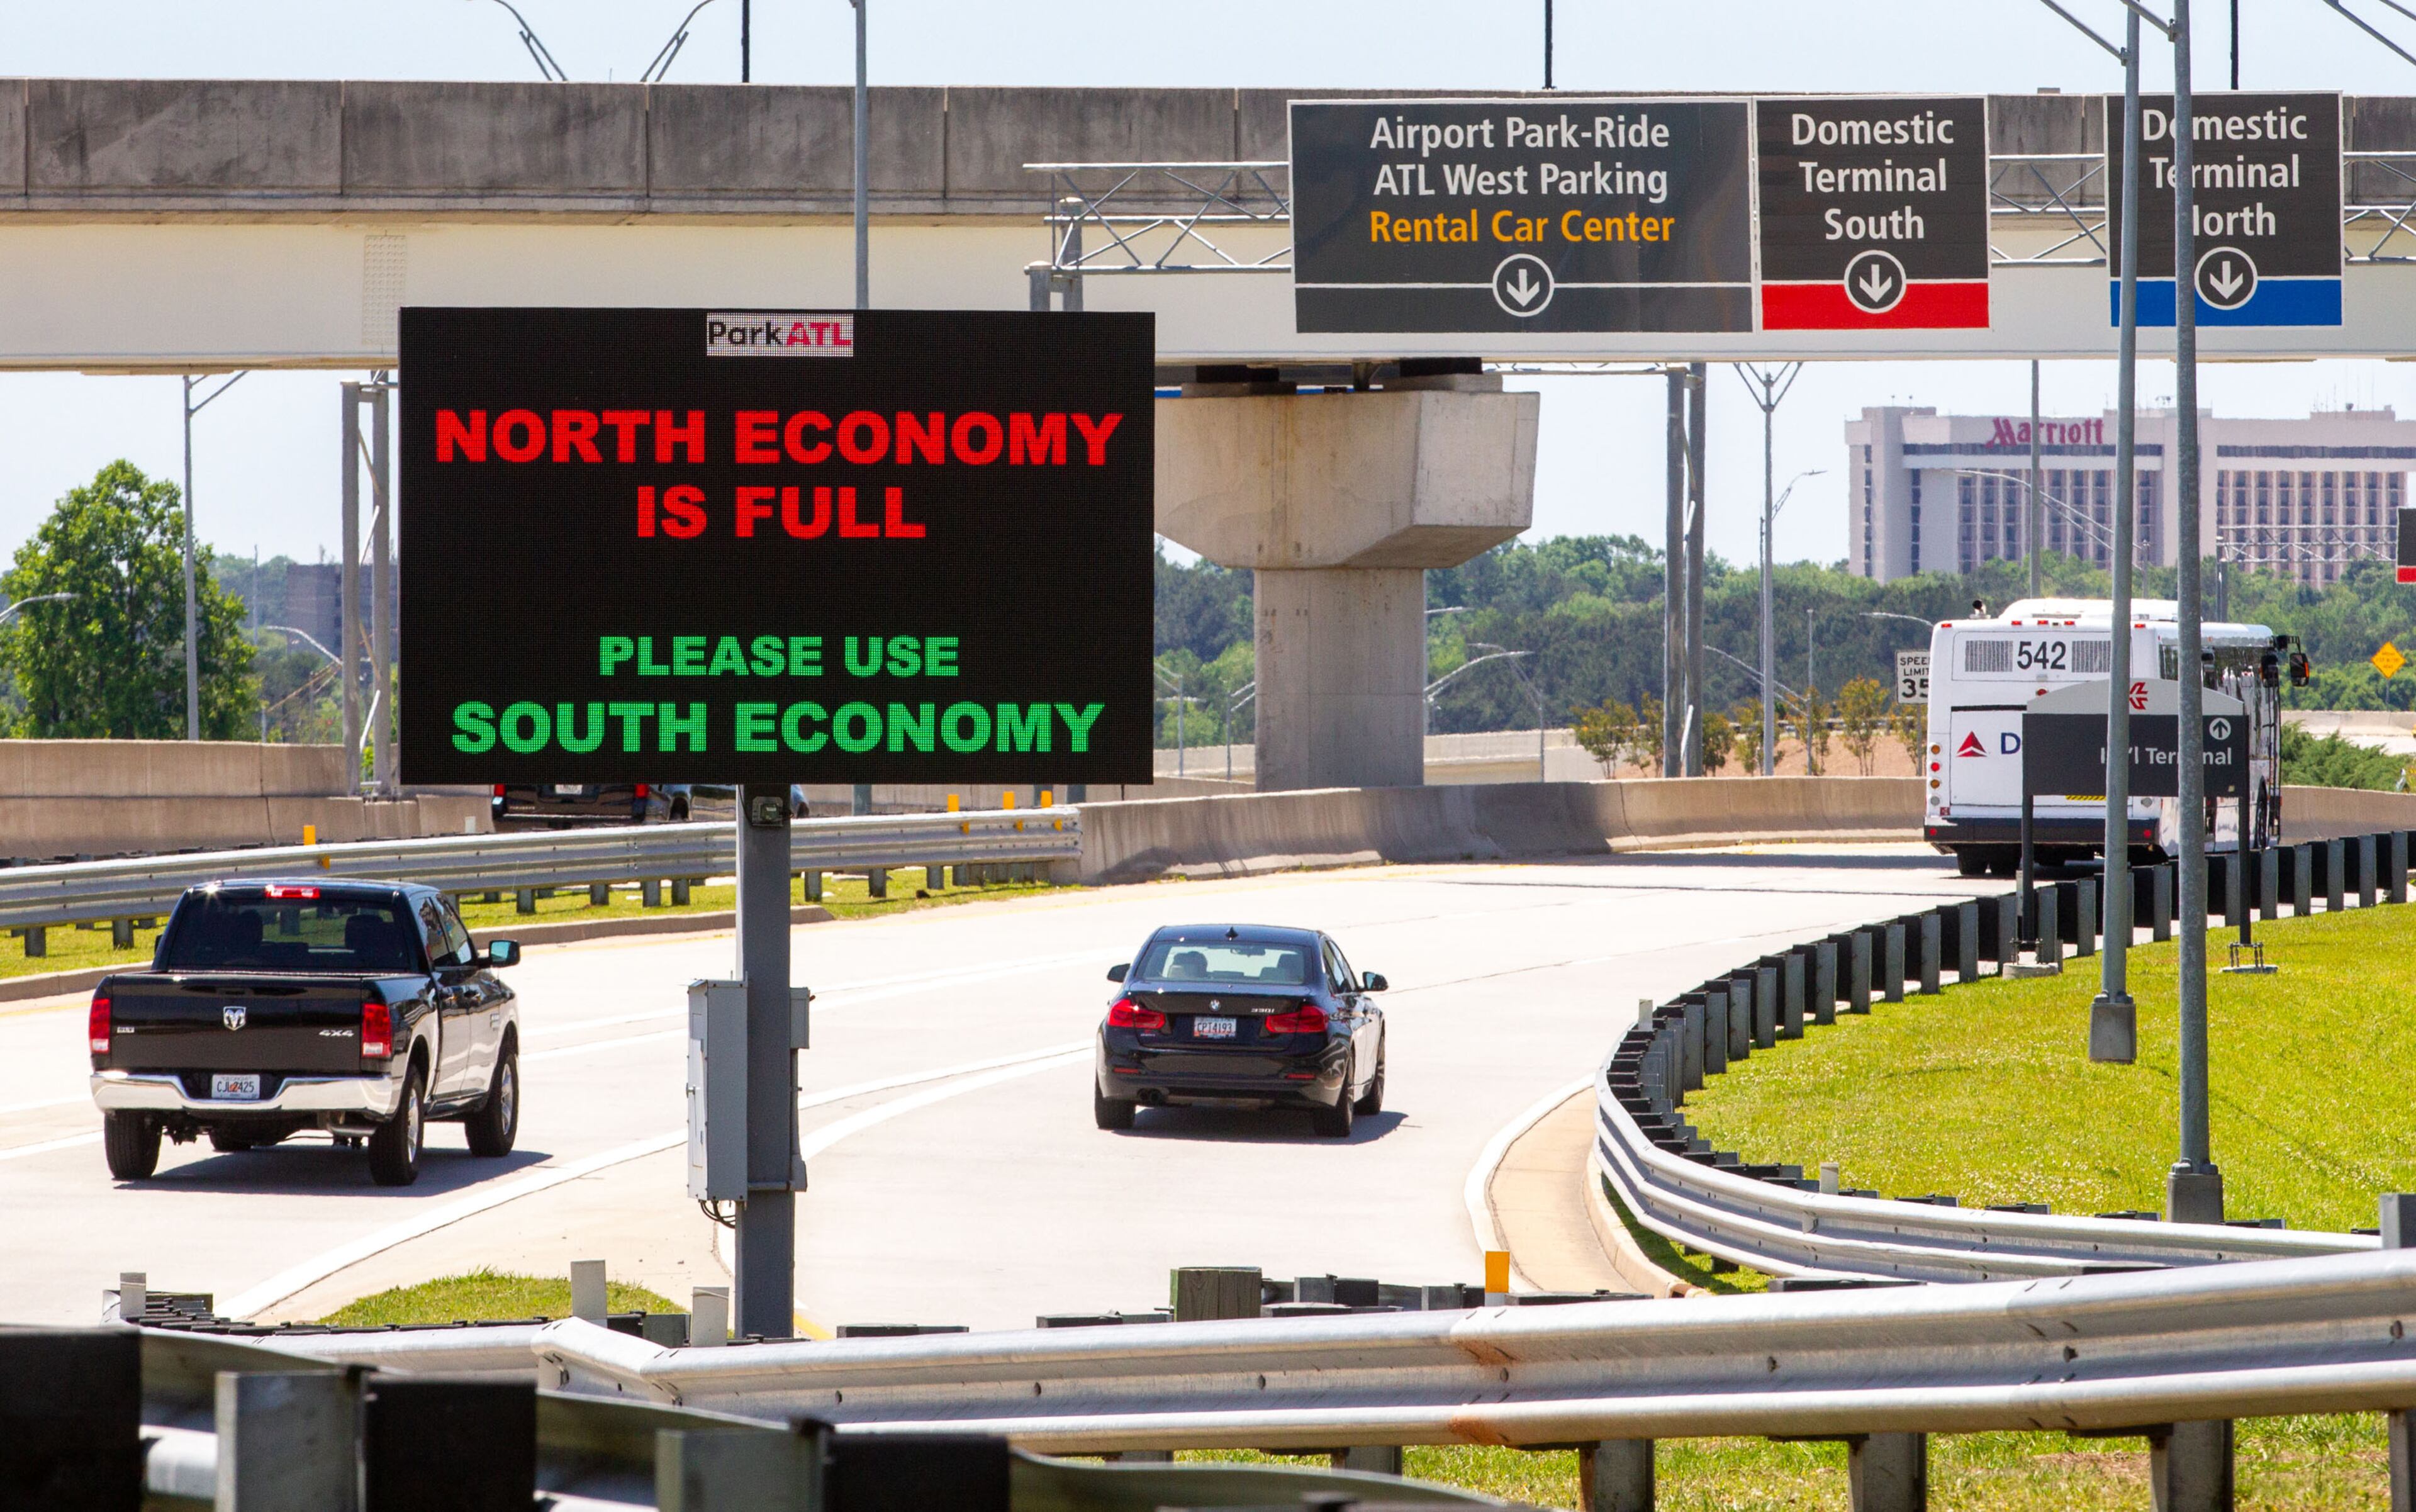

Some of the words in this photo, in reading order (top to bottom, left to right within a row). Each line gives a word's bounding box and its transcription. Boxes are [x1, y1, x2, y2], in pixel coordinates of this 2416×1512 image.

[1370, 116, 1494, 157] Airport
[1506, 115, 1670, 148] Park-Ride
[1792, 111, 1954, 145] Domestic
[1373, 164, 1435, 196] ATL
[1443, 164, 1528, 195] West
[1540, 161, 1667, 203] Parking
[1799, 158, 1947, 193] Terminal
[1370, 208, 1479, 242] Rental
[1491, 210, 1548, 242] Car
[1561, 210, 1675, 242] Center
[1825, 206, 1924, 240] South
[708, 321, 851, 346] ParkATL
[436, 409, 705, 463] NORTH
[735, 410, 1124, 466] ECONOMY
[637, 484, 707, 539] IS
[735, 486, 926, 539] FULL
[600, 635, 824, 678] PLEASE
[845, 635, 959, 678] USE
[1900, 657, 1930, 666] SPEE
[2017, 641, 2066, 669] 542
[452, 700, 707, 754] SOUTH
[735, 701, 1105, 753] ECONOMY
[2101, 746, 2139, 764] I'l
[2145, 747, 2232, 764] Ternal
